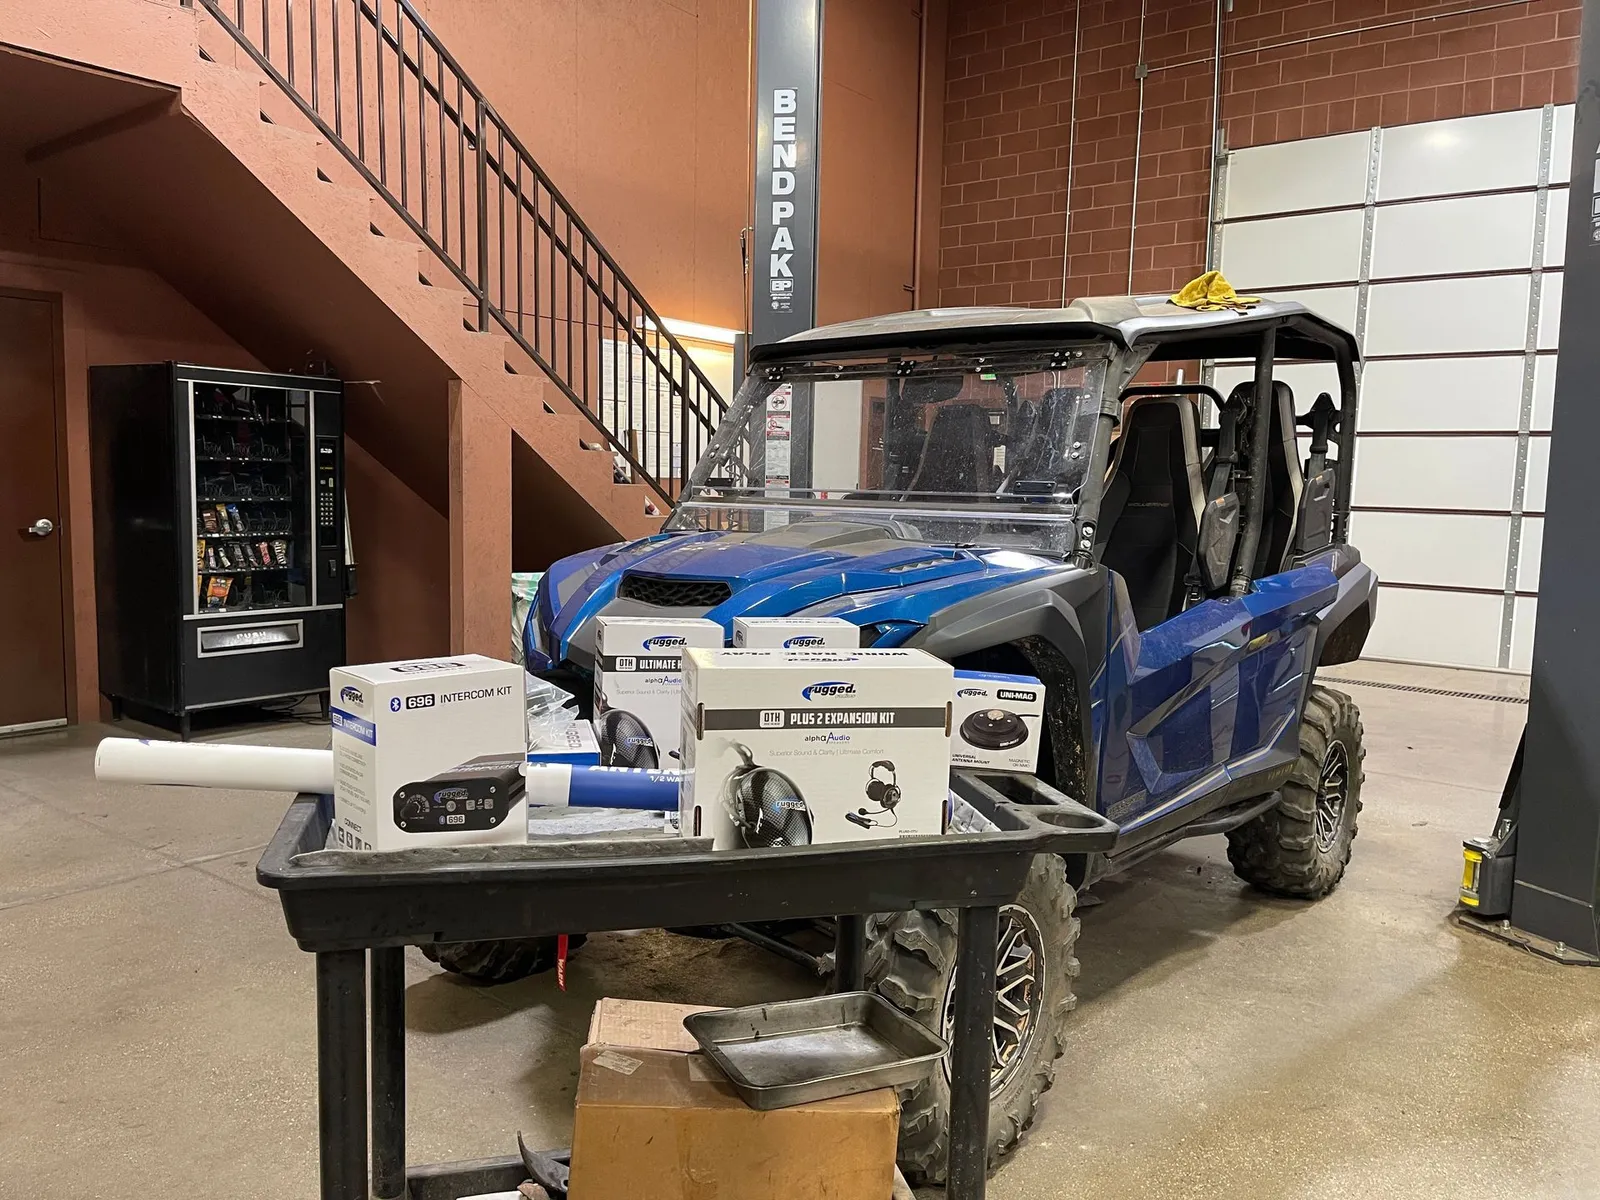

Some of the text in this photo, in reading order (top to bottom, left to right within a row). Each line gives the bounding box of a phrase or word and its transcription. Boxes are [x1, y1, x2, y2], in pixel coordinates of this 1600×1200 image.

[771, 89, 797, 278] BENDPAK
[640, 659, 676, 670] ULTIMATE
[408, 686, 512, 708] 696 INTERCOM KIT
[1000, 690, 1034, 700] UNI-MAG
[764, 712, 896, 725] OTH PLUS 2 EXPANSION KIT
[819, 749, 836, 757] Clarity
[650, 775, 665, 783] 1/2
[448, 815, 464, 824] 696
[557, 959, 565, 986] WARN
